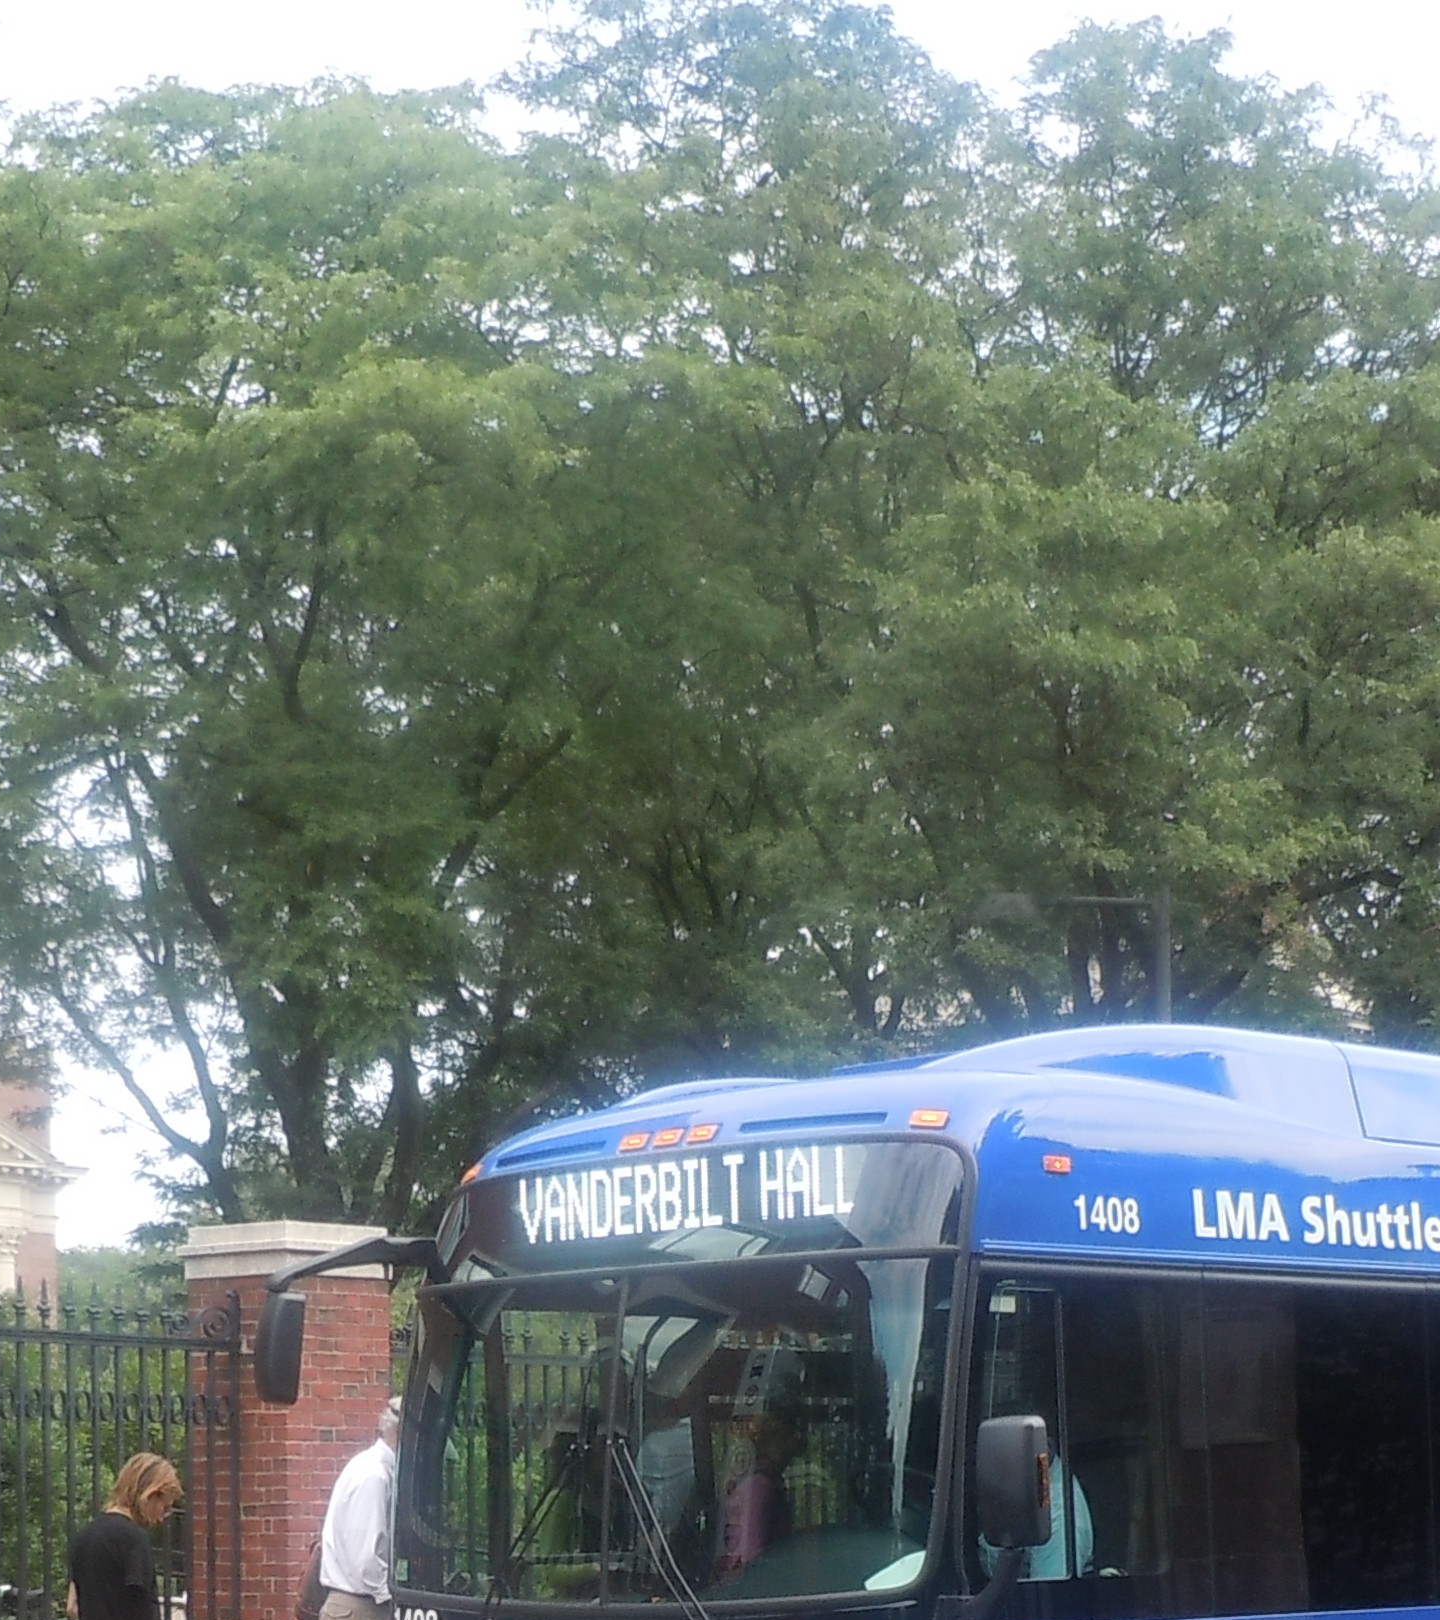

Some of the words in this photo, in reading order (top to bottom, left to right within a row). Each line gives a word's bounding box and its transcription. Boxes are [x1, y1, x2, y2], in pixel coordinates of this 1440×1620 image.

[519, 1154, 744, 1243] VANDERBILT
[759, 1145, 854, 1221] HALL
[1074, 1194, 1141, 1234] 1408
[1192, 1188, 1290, 1241] LMA
